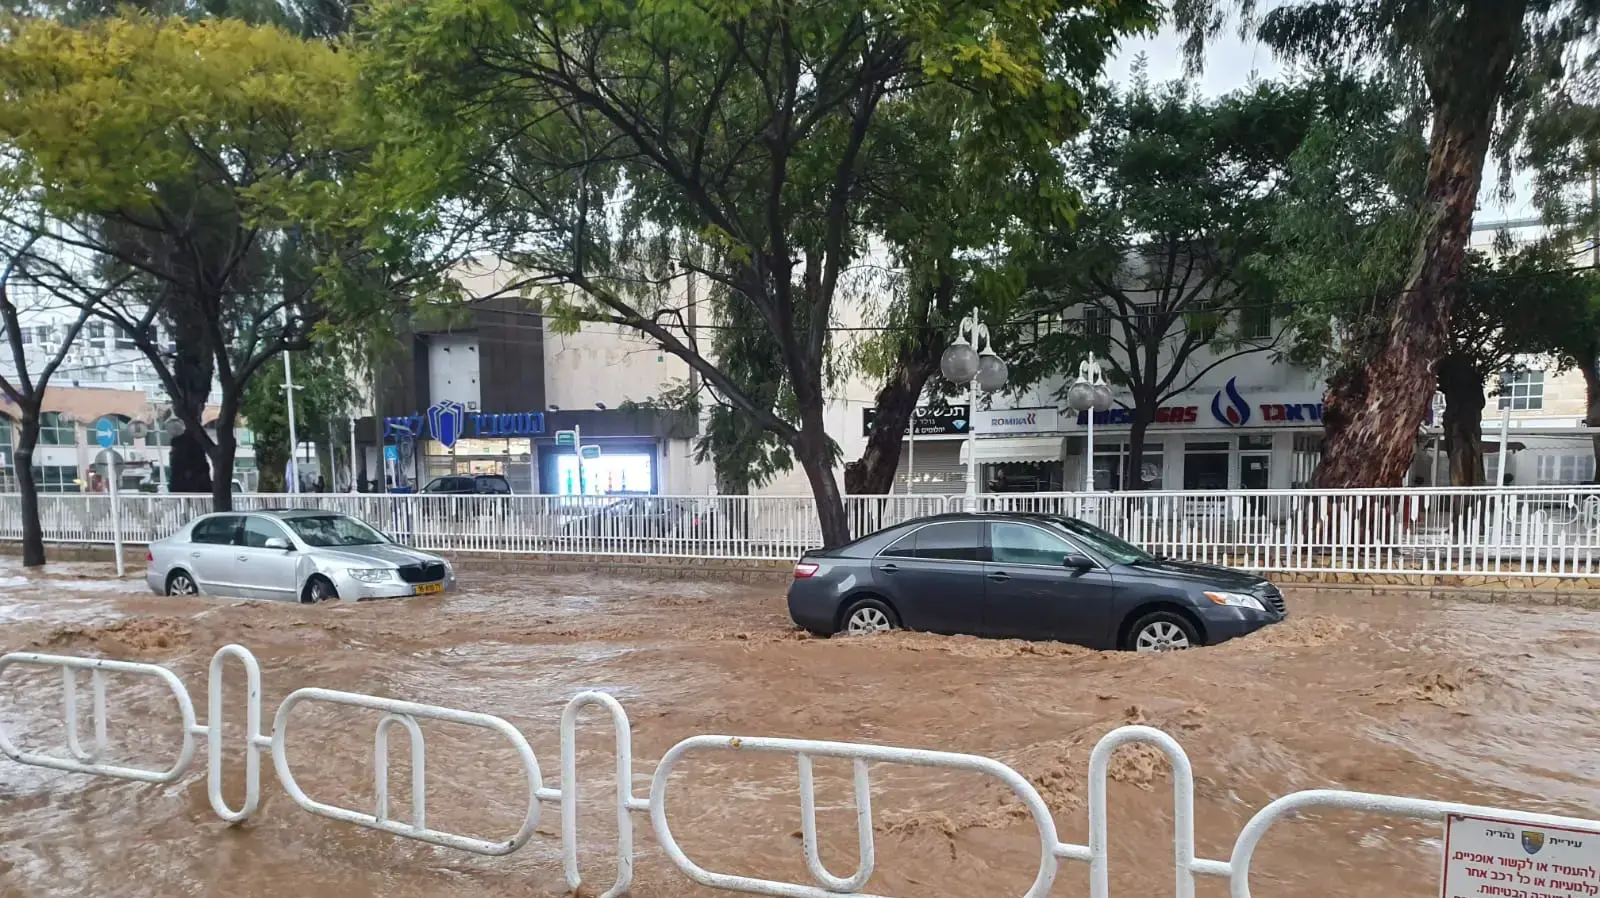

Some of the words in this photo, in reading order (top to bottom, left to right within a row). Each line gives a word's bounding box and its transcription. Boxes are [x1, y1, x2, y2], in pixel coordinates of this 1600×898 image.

[1485, 829, 1515, 840] נהריה
[1549, 837, 1582, 848] עיריית
[1452, 851, 1494, 864] אופניים,
[1497, 857, 1534, 871] לקשור
[1536, 862, 1548, 872] או
[1465, 867, 1488, 879] אחר
[1490, 871, 1513, 882] רכב
[1552, 864, 1596, 879] להעמיד
[1517, 871, 1531, 884] כל
[1534, 876, 1546, 887] או
